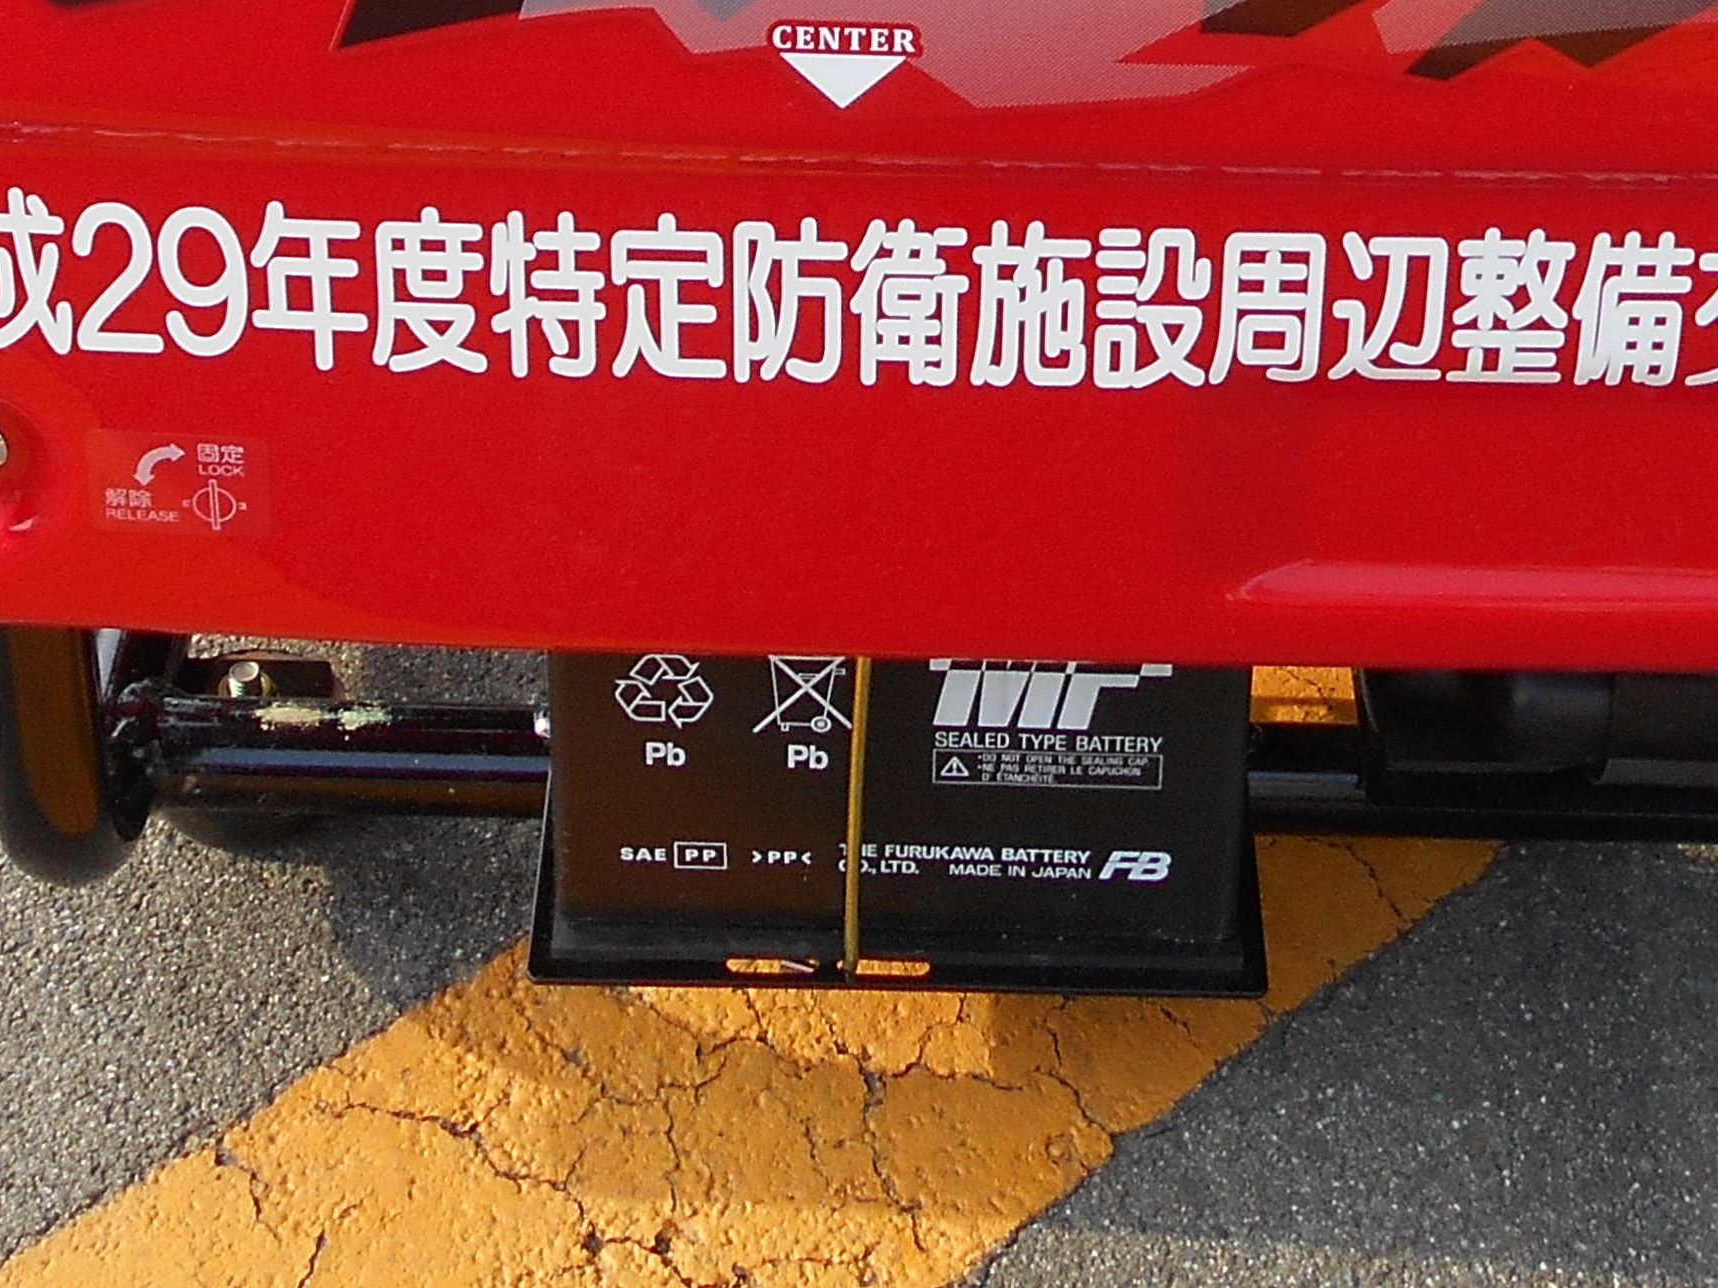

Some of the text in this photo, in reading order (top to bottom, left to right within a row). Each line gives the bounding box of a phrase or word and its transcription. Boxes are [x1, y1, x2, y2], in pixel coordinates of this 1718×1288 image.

[771, 24, 917, 55] CENTER
[197, 443, 244, 464] 固定
[198, 465, 244, 477] LOCK
[105, 488, 152, 508] 解除
[106, 508, 179, 523] RELEASE
[934, 731, 1163, 753] SEALED TYPE BATTERY
[645, 741, 686, 766] Pb
[787, 744, 829, 770] Pb
[1001, 754, 1020, 764] NOT
[1026, 755, 1052, 765] OPEN
[1058, 755, 1076, 765] THE
[1081, 756, 1123, 766] SEALING
[1000, 763, 1019, 774] PAS
[1070, 765, 1082, 775] LE
[620, 847, 667, 862] SAE
[684, 848, 718, 862] PP
[884, 844, 994, 861] FURUKAWA
[1002, 847, 1091, 864] BATTERY
[949, 863, 1001, 877] MADE
[1008, 864, 1026, 878] IN
[1032, 865, 1091, 879] JAPAN
[1098, 850, 1172, 881] FB
